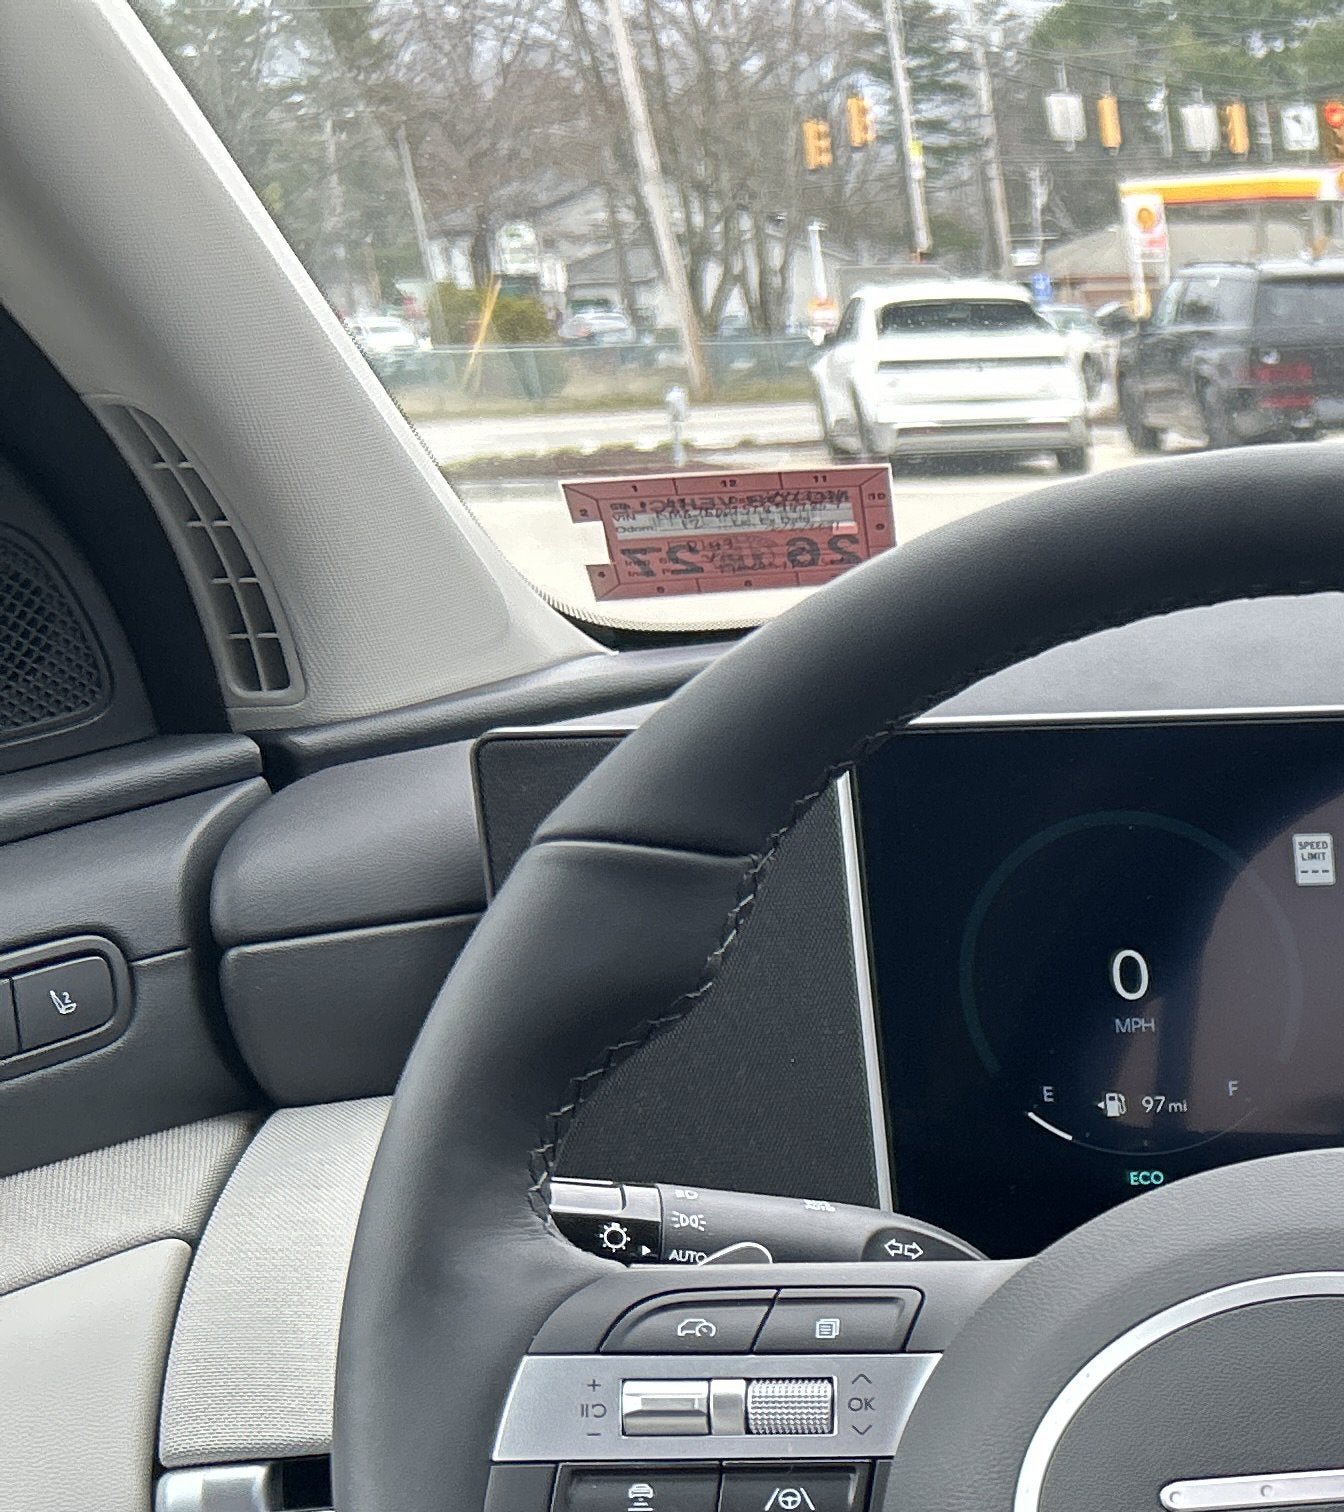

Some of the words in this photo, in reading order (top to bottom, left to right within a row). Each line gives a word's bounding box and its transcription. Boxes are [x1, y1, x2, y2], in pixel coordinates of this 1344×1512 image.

[1297, 840, 1329, 851] SPEED
[1300, 851, 1327, 862] LIMIT
[1113, 950, 1148, 1000] 0
[1116, 1018, 1155, 1032] MPH
[1043, 1086, 1054, 1102] E
[1229, 1081, 1237, 1096] F
[1142, 1096, 1165, 1112] 97
[1169, 1100, 1187, 1112] mi
[1130, 1171, 1168, 1190] ECO
[668, 1249, 707, 1263] AUTO
[848, 1398, 875, 1411] OK
